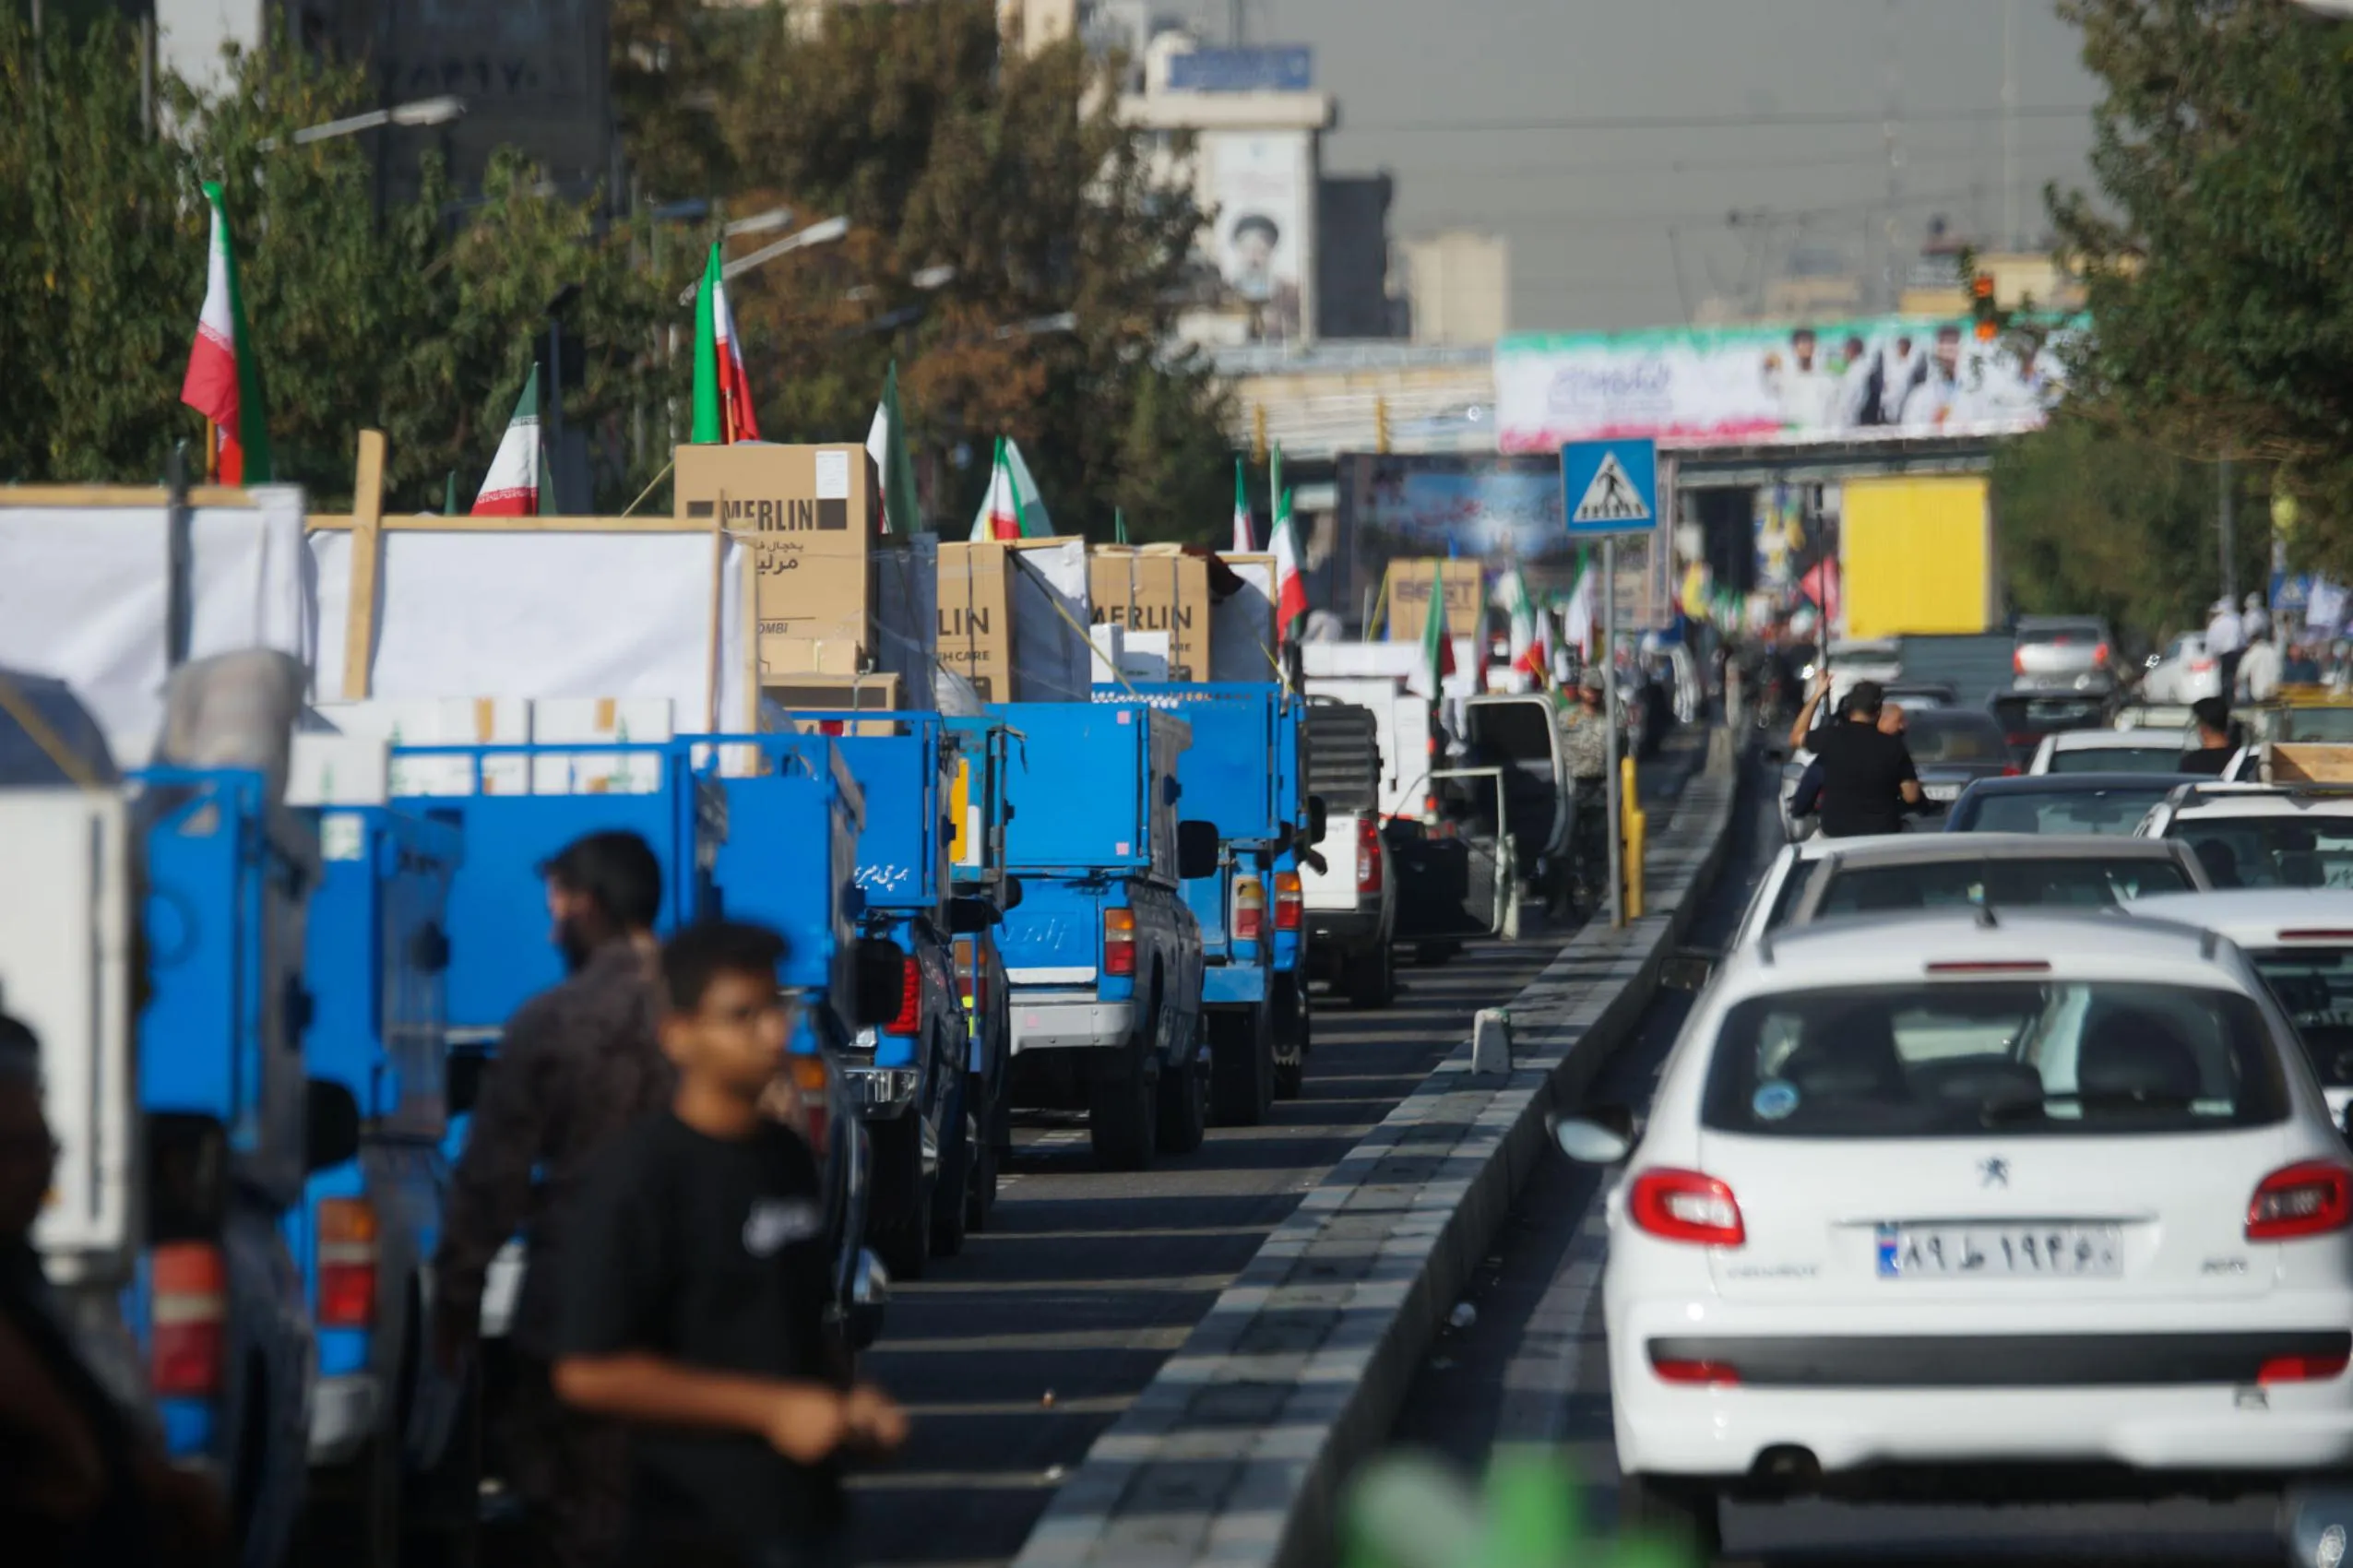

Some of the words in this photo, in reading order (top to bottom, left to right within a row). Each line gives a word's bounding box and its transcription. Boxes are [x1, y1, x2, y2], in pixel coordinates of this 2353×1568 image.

[757, 553, 799, 576] مرلی
[758, 622, 789, 636] OMBI
[937, 607, 989, 636] LIN
